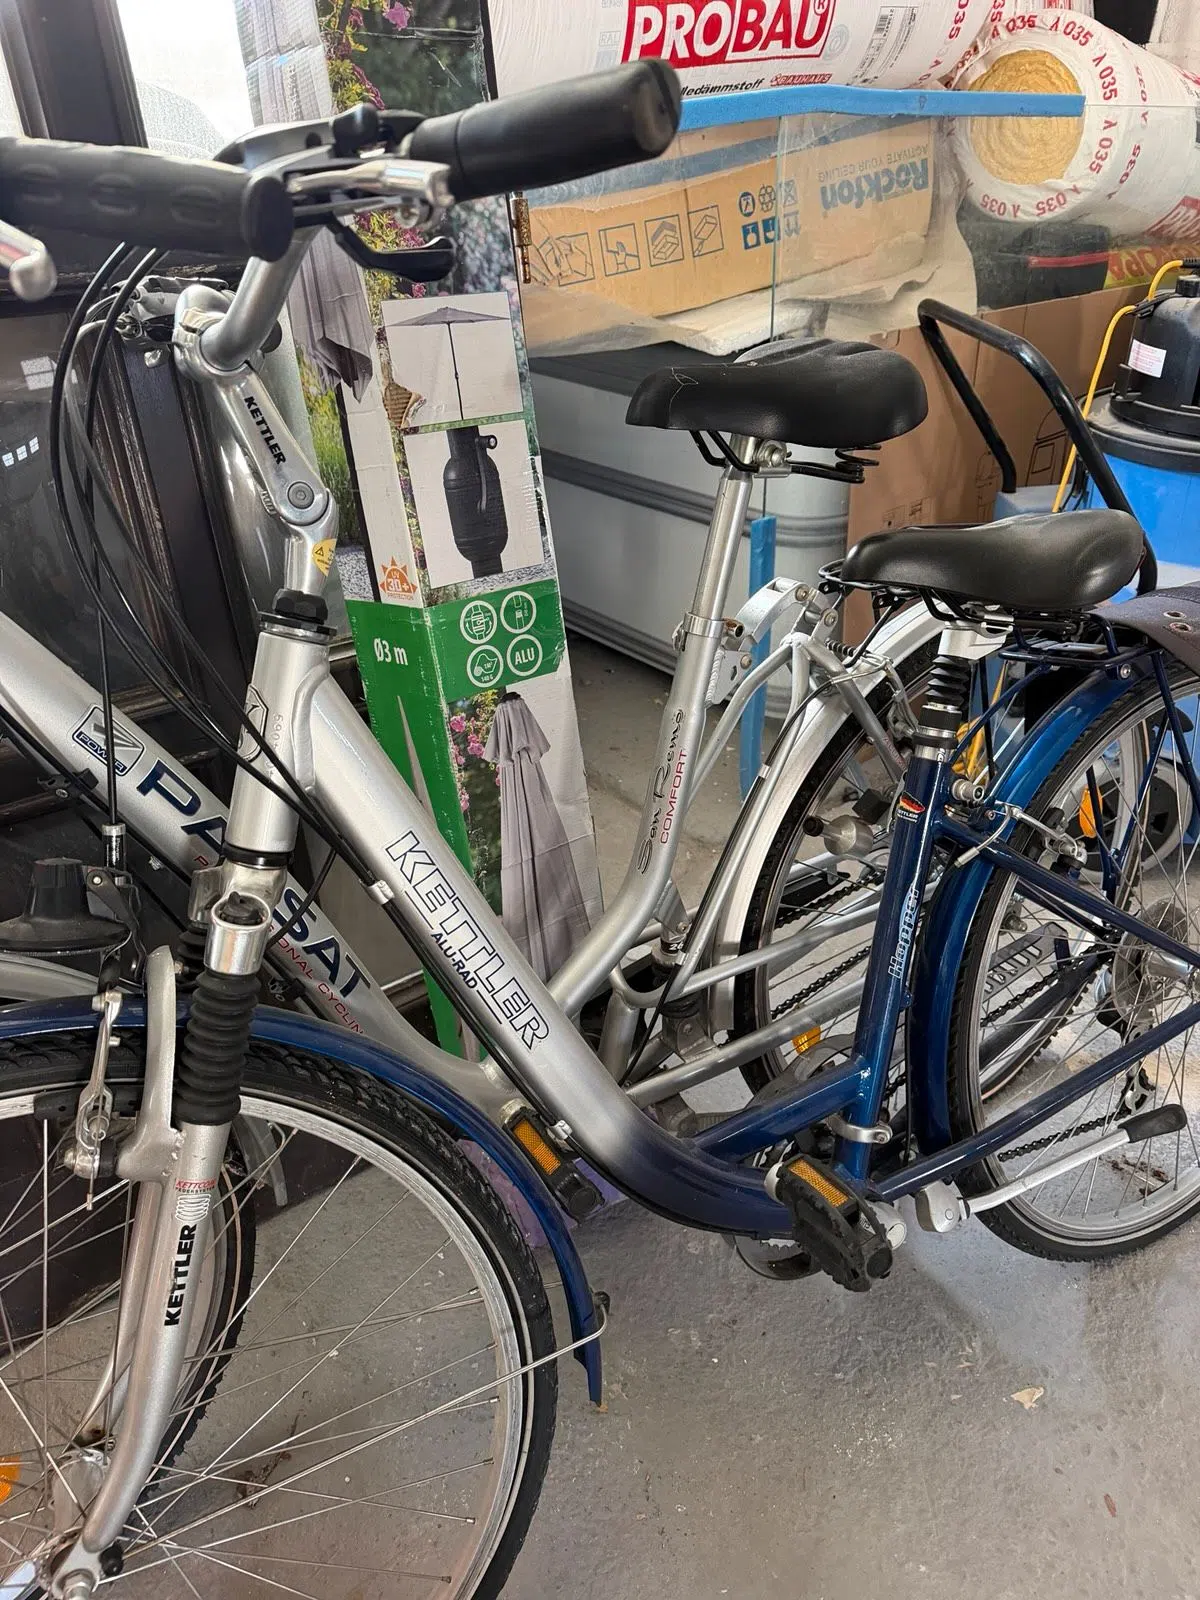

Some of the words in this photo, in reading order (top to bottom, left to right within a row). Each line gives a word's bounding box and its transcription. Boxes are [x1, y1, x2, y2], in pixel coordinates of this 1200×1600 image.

[1063, 20, 1094, 46] 035
[1099, 66, 1118, 101] 035
[1089, 138, 1114, 175] 035
[820, 158, 929, 211] Rockfon
[244, 396, 287, 465] KETTLER
[393, 647, 409, 665] m
[514, 647, 535, 665] ALU
[76, 731, 127, 772] POWR
[660, 749, 688, 844] COMFORT
[136, 758, 371, 999] PASAT
[385, 830, 550, 1050] KETTLER
[888, 887, 920, 979] Hopper
[431, 932, 478, 990] ALU-RAD
[164, 1223, 198, 1326] KETTLER
